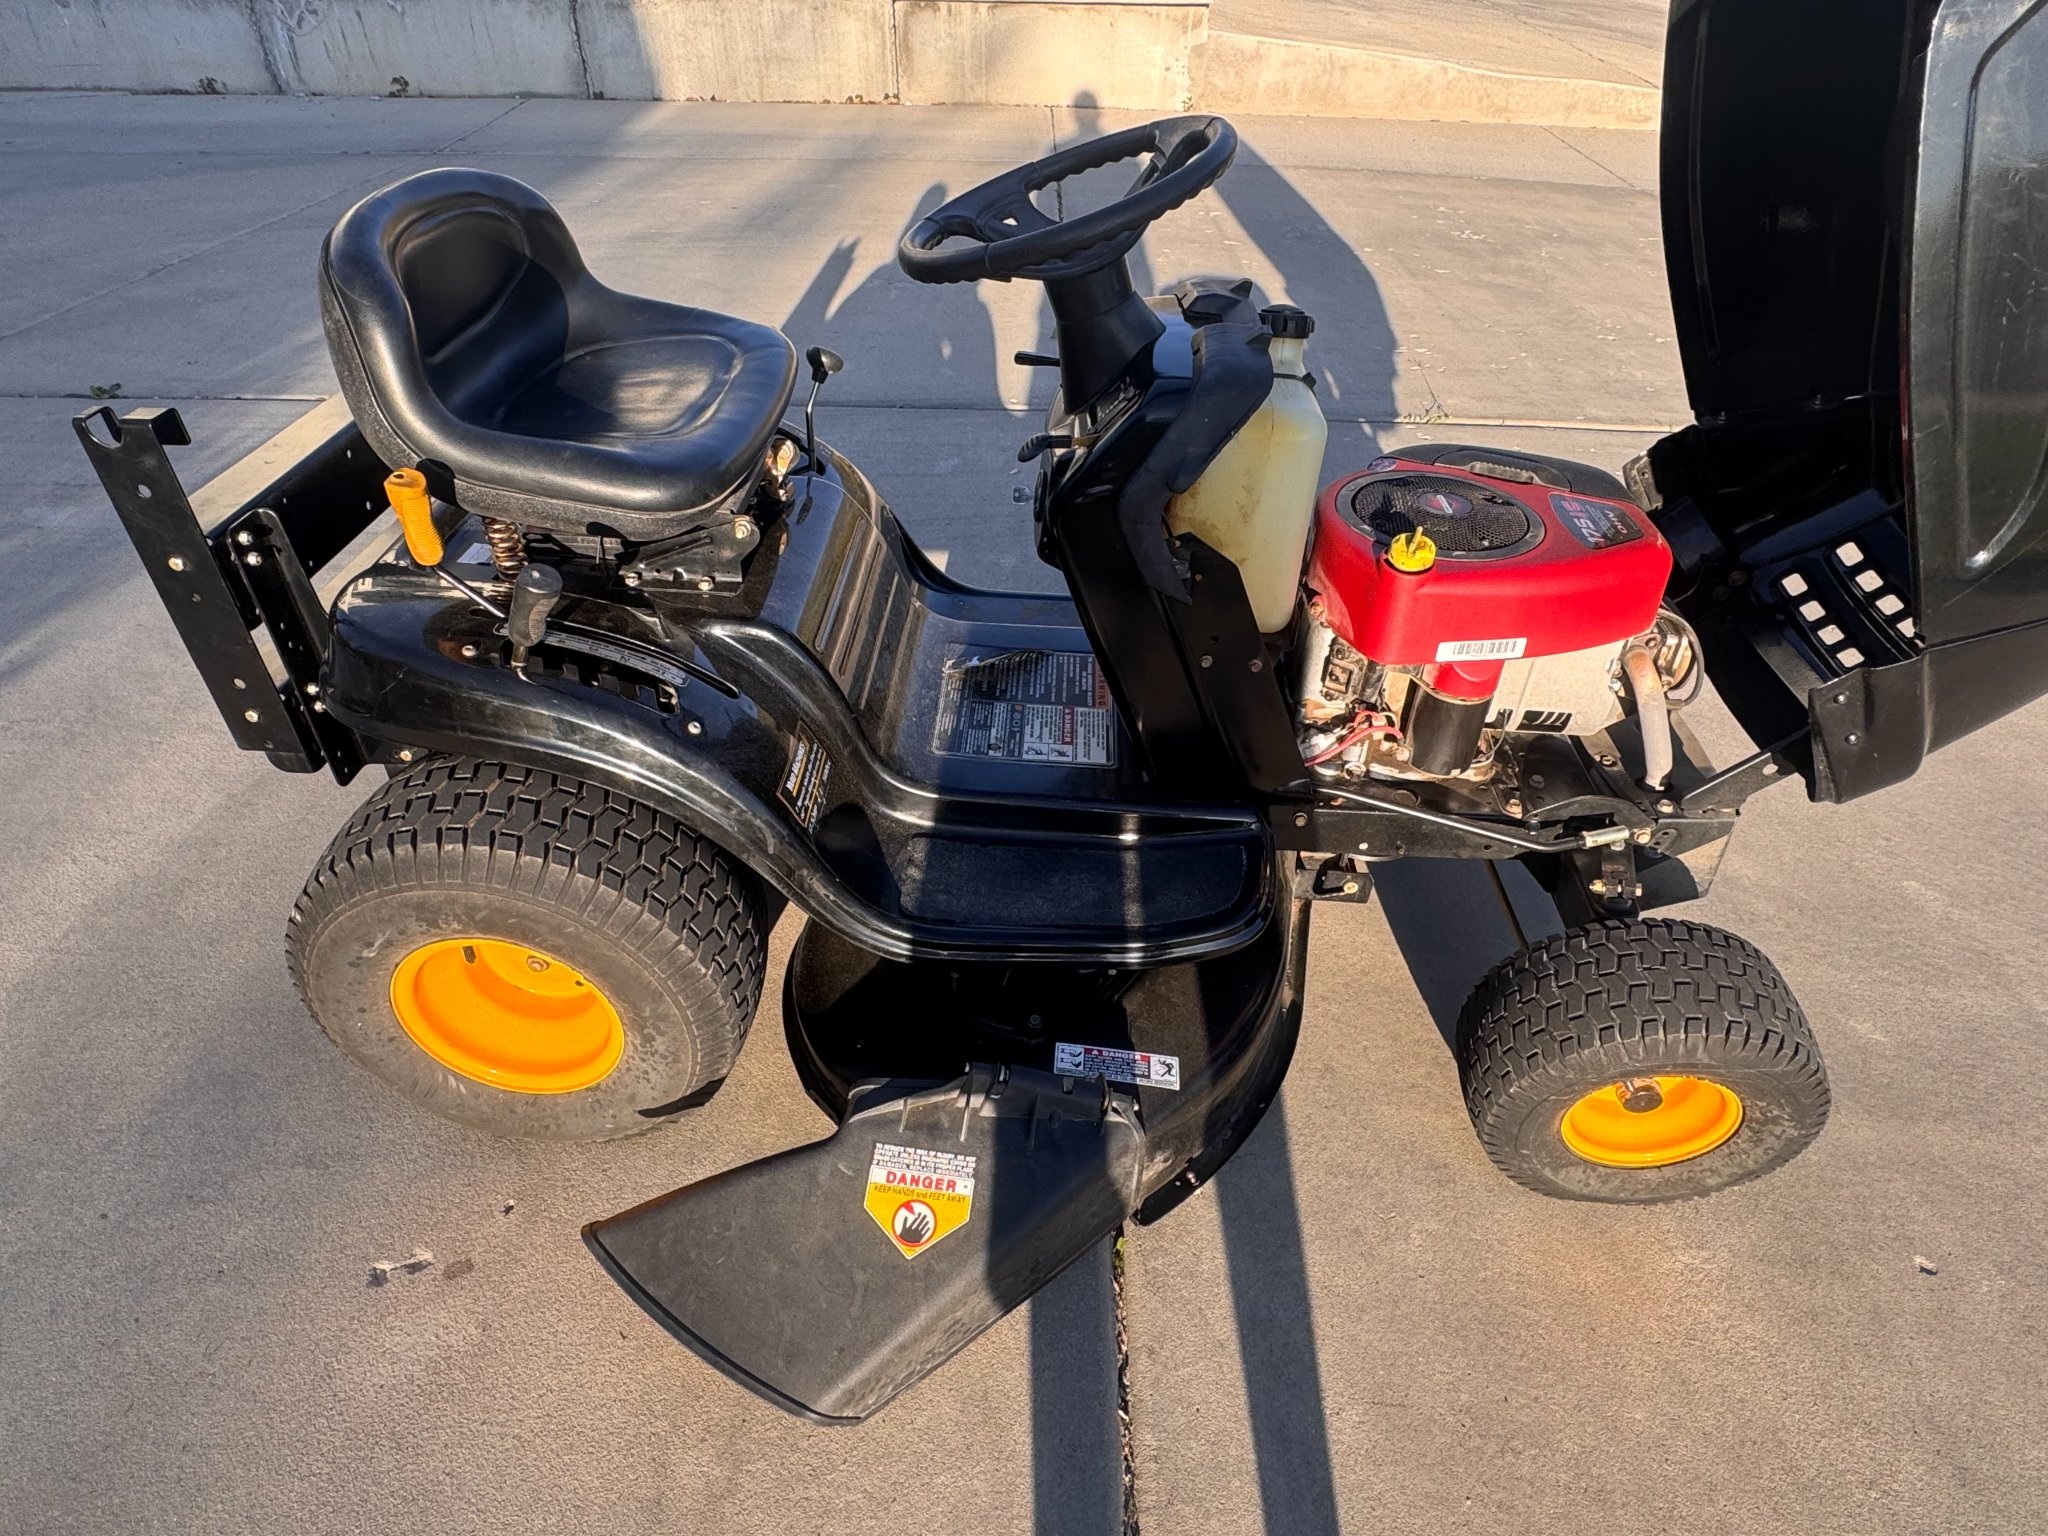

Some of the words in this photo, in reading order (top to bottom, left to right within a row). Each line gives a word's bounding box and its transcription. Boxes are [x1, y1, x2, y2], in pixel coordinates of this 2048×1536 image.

[1603, 509, 1629, 534] OHV
[1063, 714, 1073, 743] DANGER
[1102, 1050, 1141, 1061] DANGER
[885, 1170, 957, 1193] DANGER
[874, 1184, 891, 1193] KEEP
[892, 1186, 915, 1197] HANDS
[916, 1191, 928, 1199] and
[928, 1192, 944, 1201] FEET
[946, 1194, 966, 1204] AWAY
